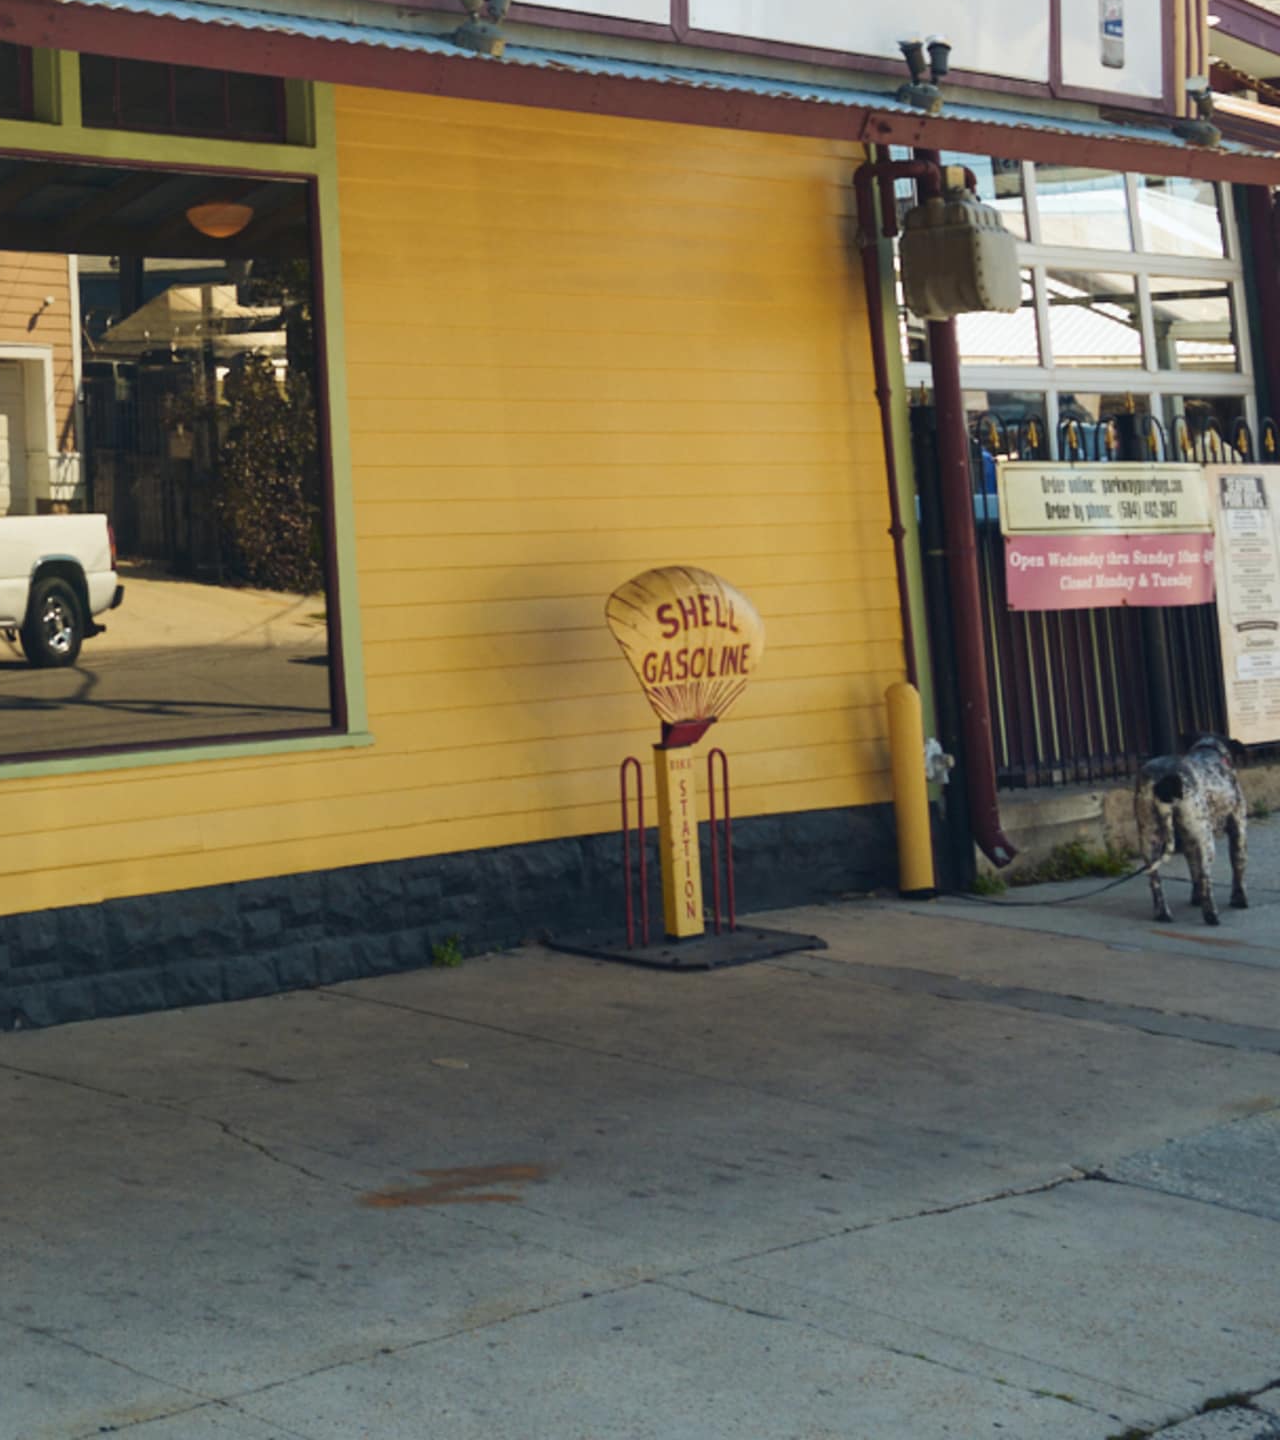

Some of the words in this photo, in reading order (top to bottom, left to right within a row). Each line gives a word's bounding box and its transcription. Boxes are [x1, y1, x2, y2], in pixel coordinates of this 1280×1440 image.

[1009, 551, 1044, 572] Open
[1048, 552, 1104, 568] Wednesday
[1106, 552, 1130, 565] thru
[1132, 550, 1175, 567] Sunday
[656, 593, 741, 639] SHELL
[642, 643, 751, 684] GASOLINE
[678, 779, 696, 921] STATION
